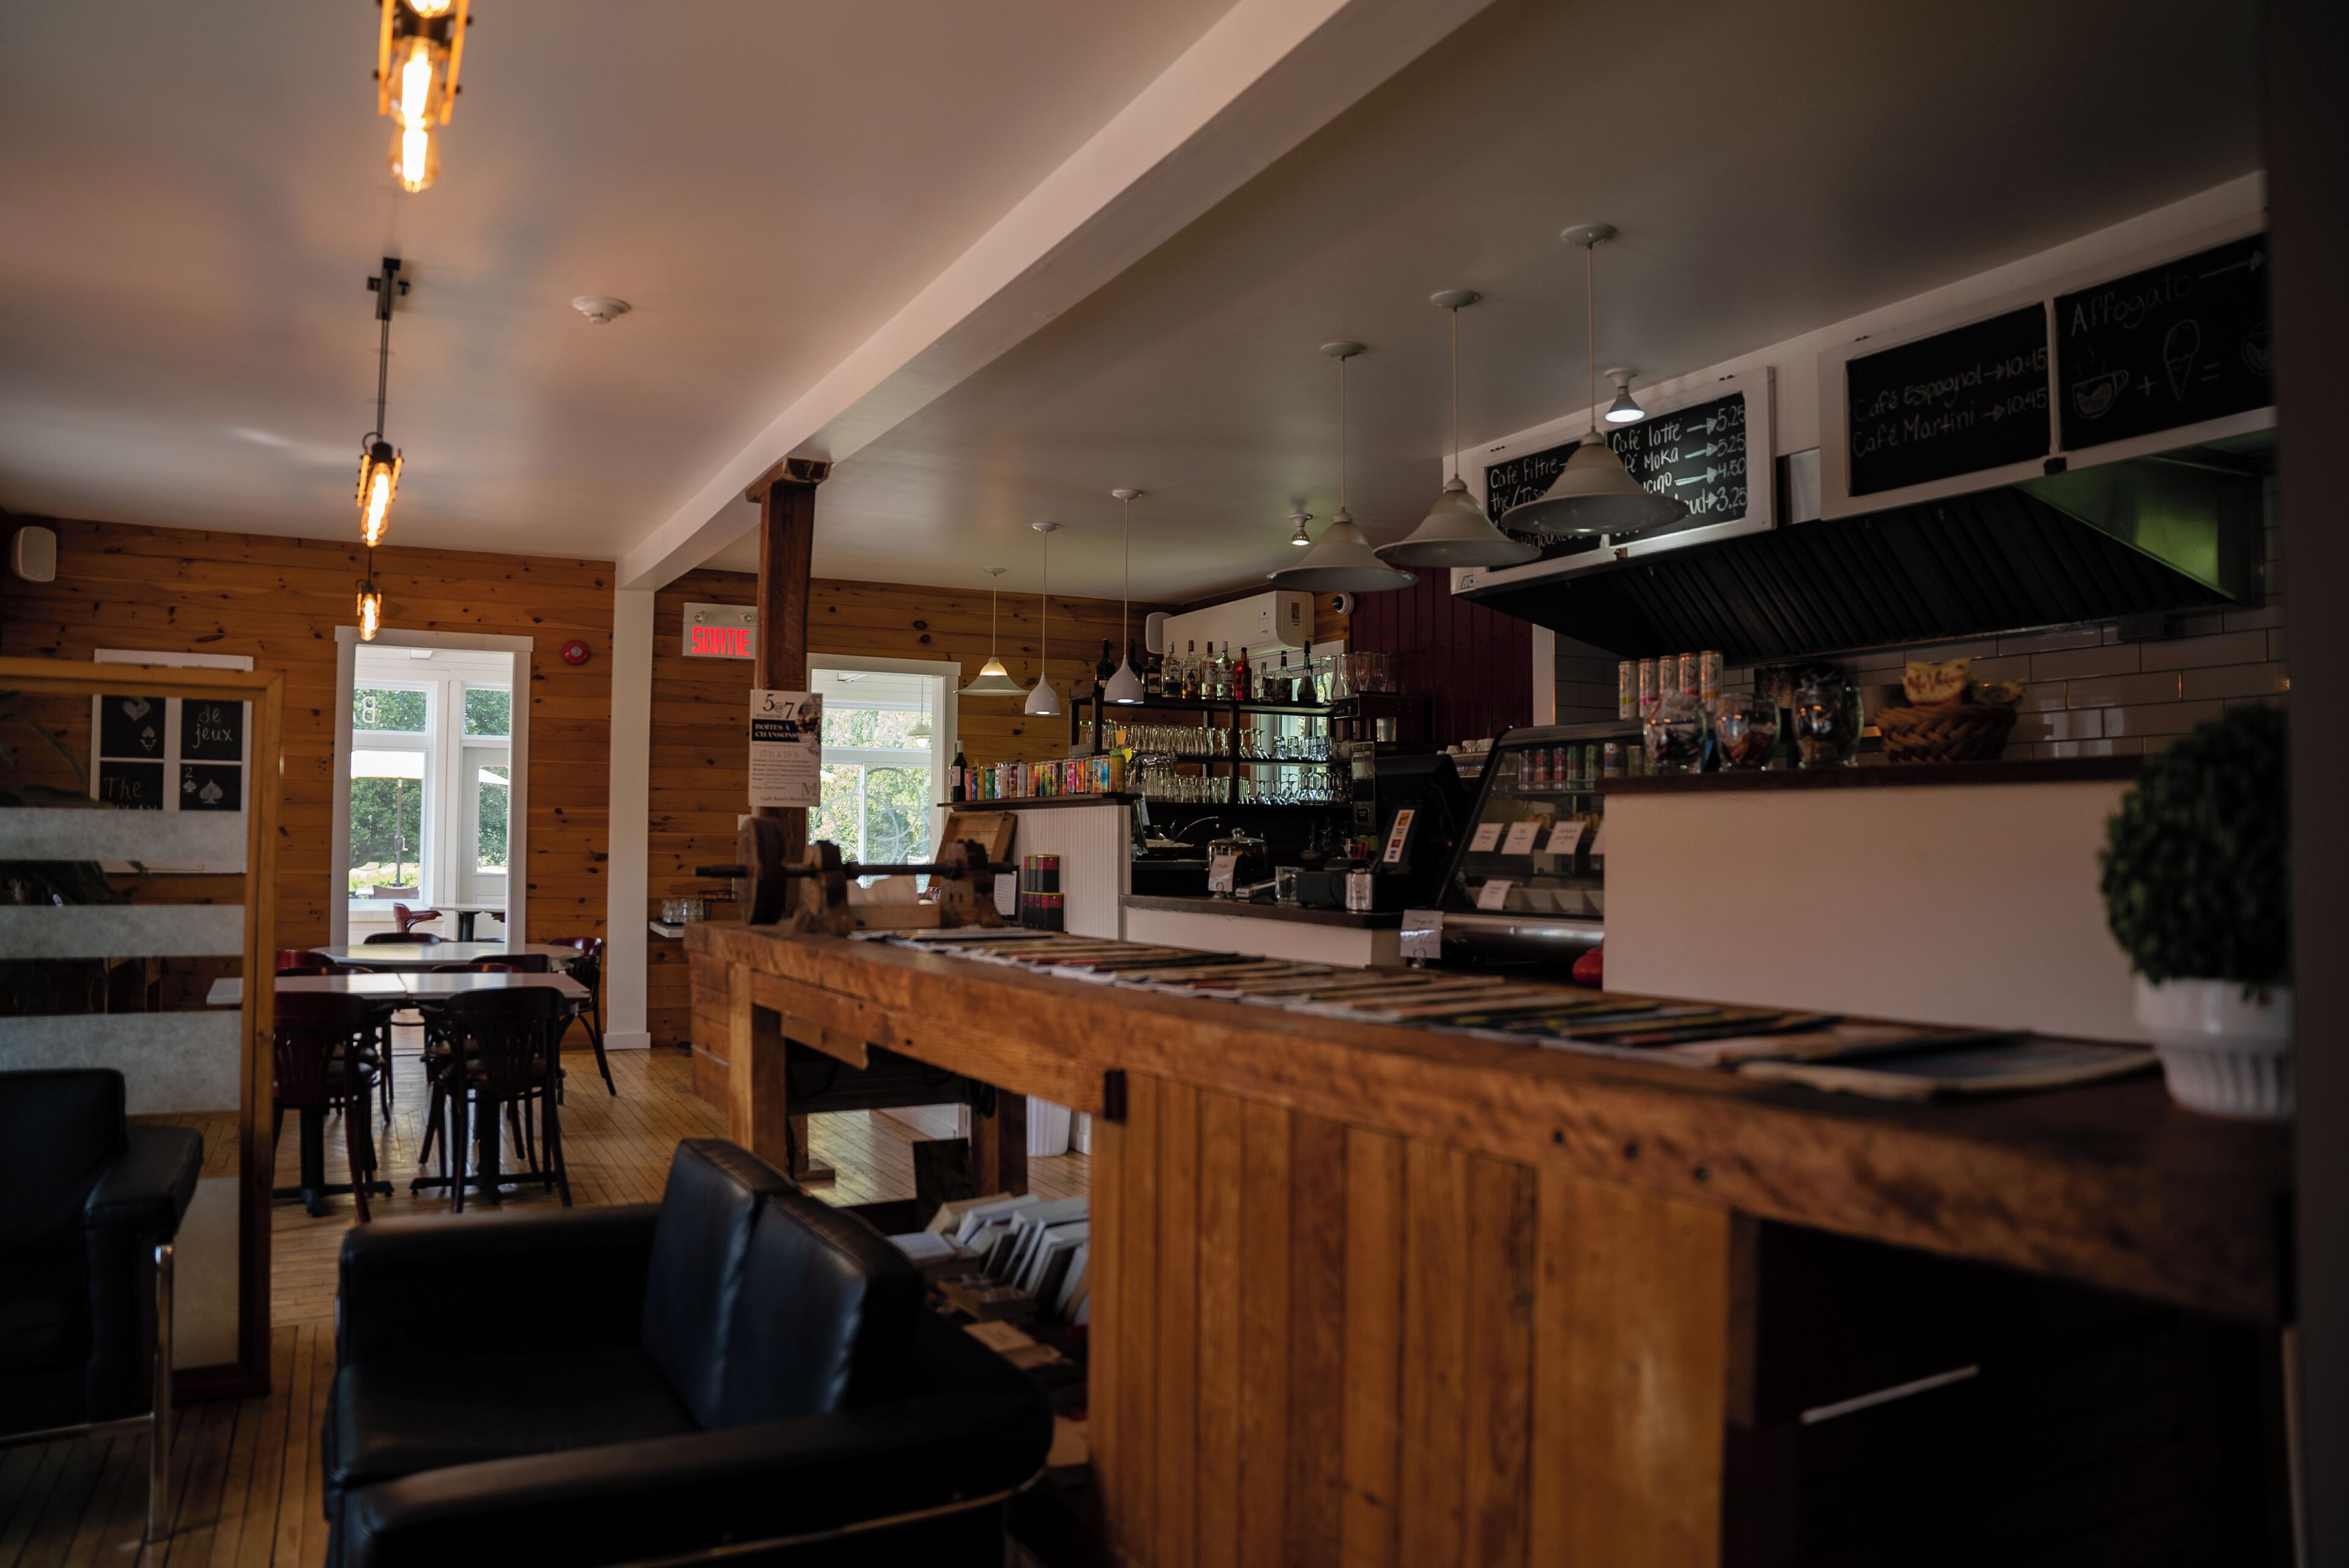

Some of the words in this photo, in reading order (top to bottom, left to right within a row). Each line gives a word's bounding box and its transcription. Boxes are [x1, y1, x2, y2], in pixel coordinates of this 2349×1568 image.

[1854, 390, 1899, 423] Café
[1904, 362, 1982, 409] Espagnol
[1852, 423, 1899, 457] Café
[1904, 399, 1975, 442] Martini
[1612, 429, 1641, 454] Café
[1490, 465, 1518, 489] Café
[1718, 457, 1746, 479] 4.50
[691, 626, 750, 656] SORTIE
[198, 704, 221, 723] de
[192, 724, 233, 749] jeux
[103, 777, 143, 800] The
